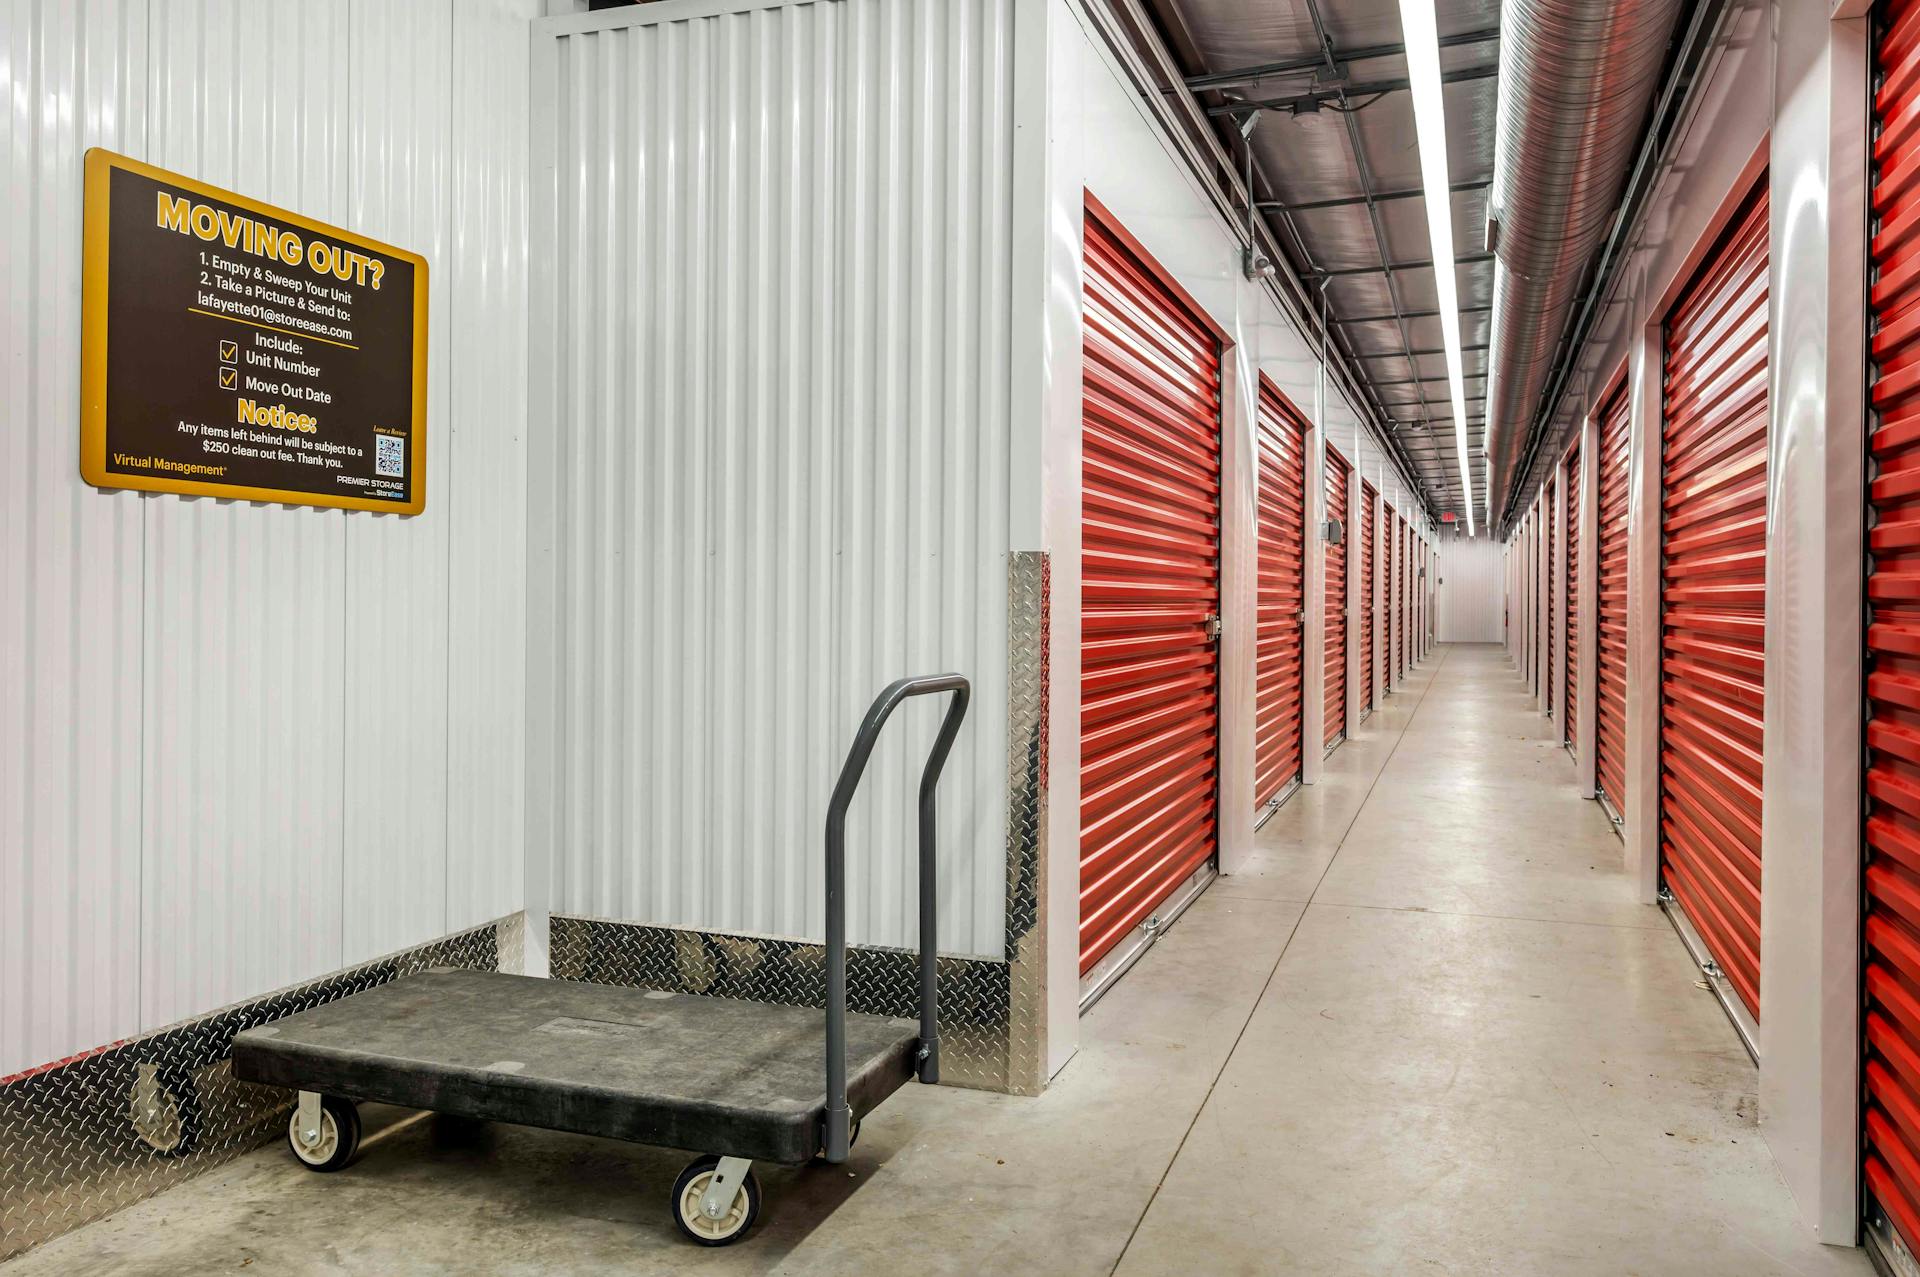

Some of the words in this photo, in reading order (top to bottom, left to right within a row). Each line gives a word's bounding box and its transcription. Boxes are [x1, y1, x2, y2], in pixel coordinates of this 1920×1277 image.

[157, 191, 303, 266] MOVING
[308, 241, 385, 290] OUT?
[200, 252, 209, 266] 1.
[212, 255, 251, 279] Empty
[253, 267, 262, 280] &
[265, 271, 302, 292] Sweep
[305, 281, 329, 298] Your
[330, 288, 352, 304] Unit
[200, 272, 212, 286] 2.
[215, 275, 242, 293] Take
[245, 285, 252, 296] a
[255, 285, 295, 307] Picture
[298, 297, 306, 310] &
[308, 300, 334, 317] Send
[337, 307, 351, 321] to:
[198, 290, 352, 341] lafayette01@storeease.com
[255, 332, 303, 355] Include:
[246, 350, 271, 368] Unit
[274, 356, 320, 377] Number
[245, 376, 279, 394] Move
[281, 383, 303, 399] Out
[305, 387, 331, 404] Date
[238, 398, 317, 434] Notice:
[178, 421, 199, 436] Any
[200, 424, 229, 439] items
[231, 428, 247, 441] left
[249, 430, 282, 446] behind
[284, 437, 300, 448] will
[302, 438, 313, 450] be
[314, 441, 346, 455] subject
[347, 447, 356, 456] to
[357, 449, 363, 457] a
[203, 439, 230, 454] $250
[231, 446, 258, 459] clean
[260, 450, 276, 460] out
[278, 450, 295, 462] fee.
[297, 452, 324, 466] Thank
[325, 457, 343, 469] you.
[113, 453, 151, 469] Virtual
[336, 475, 370, 487] PREMIER
[371, 479, 404, 490] STORAGE
